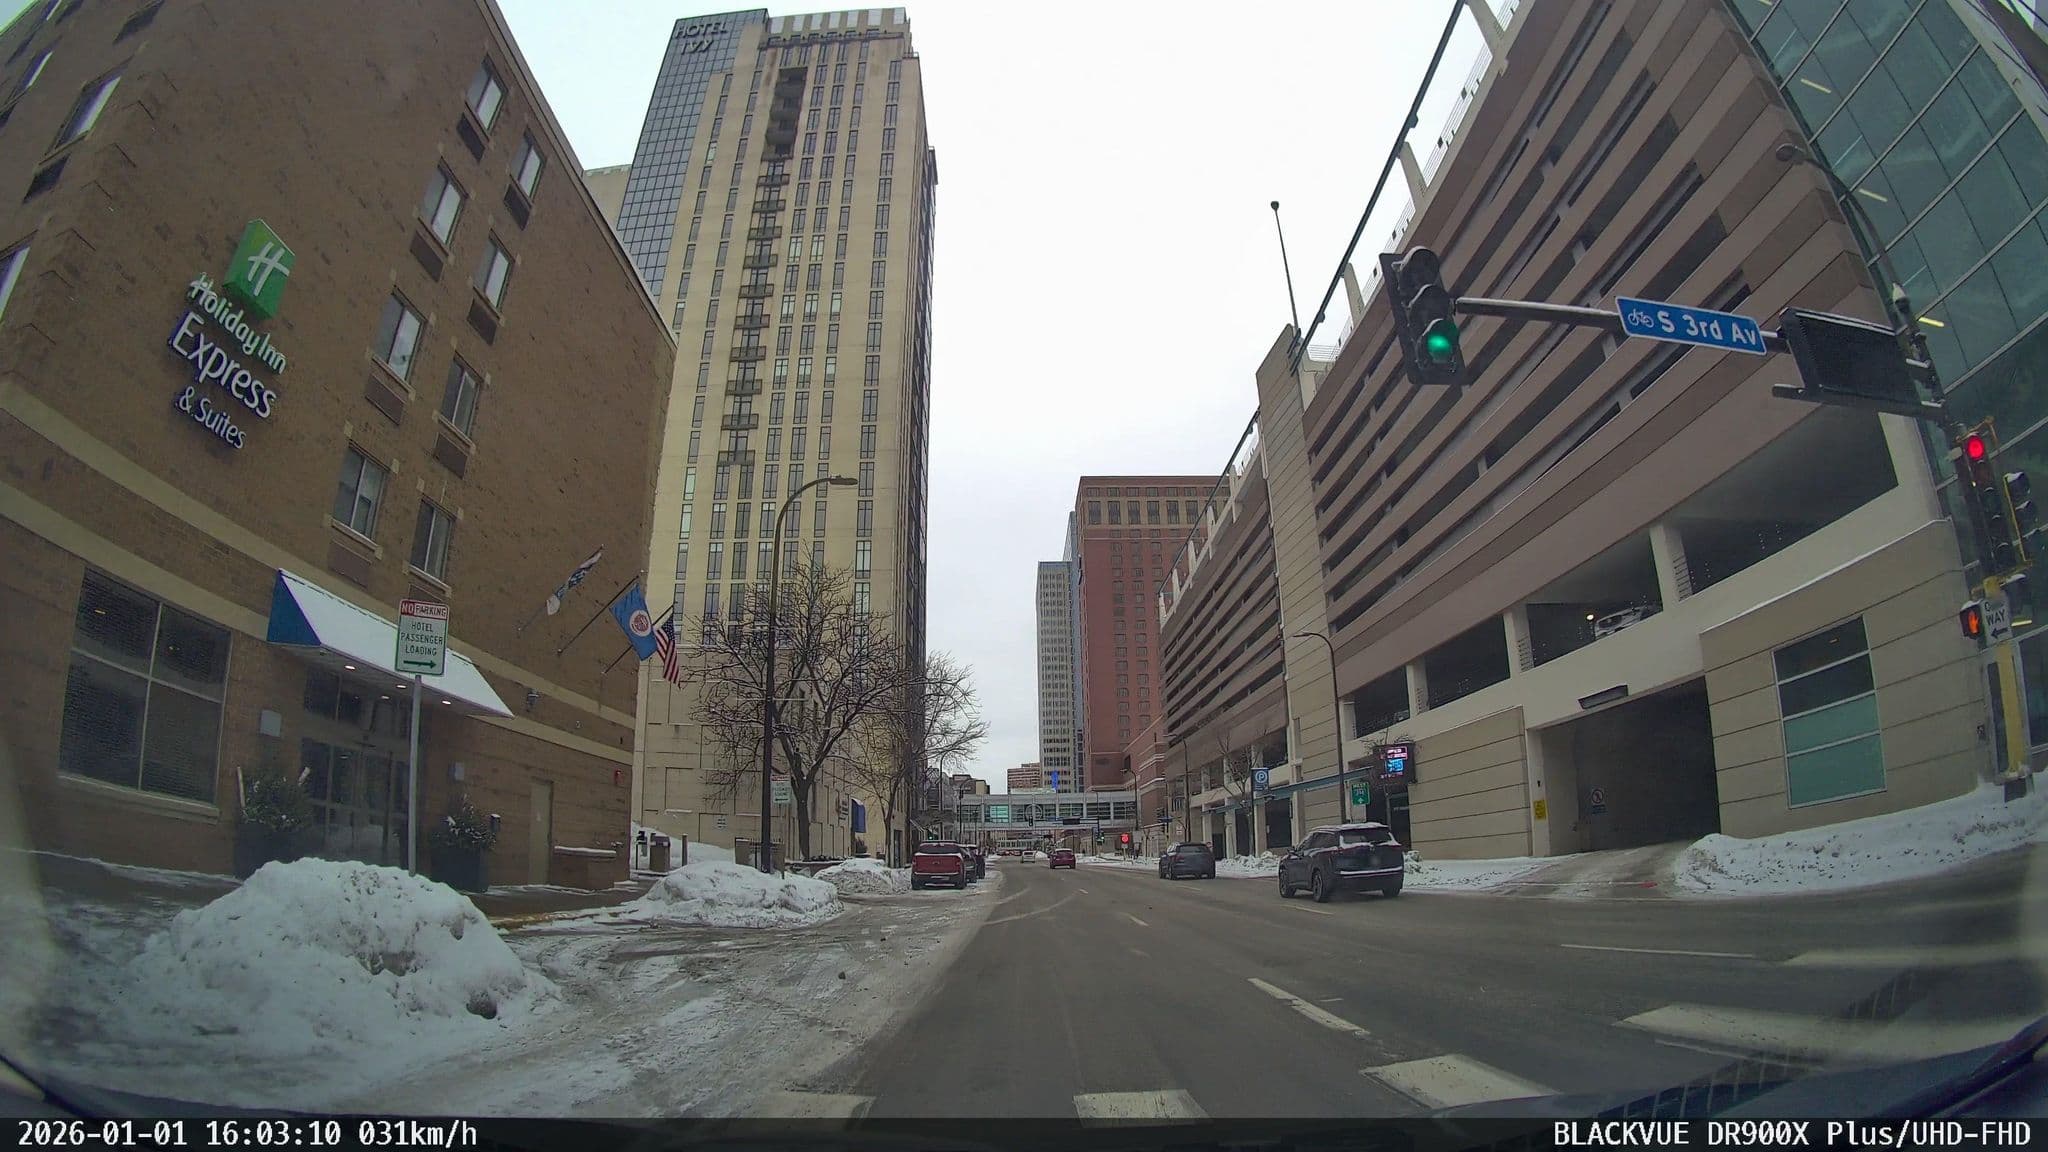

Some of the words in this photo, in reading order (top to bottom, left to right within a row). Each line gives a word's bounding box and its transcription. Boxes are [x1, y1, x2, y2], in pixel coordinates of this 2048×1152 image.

[675, 22, 728, 39] HOTEL
[680, 37, 714, 55] IVY
[188, 272, 260, 356] Holiday
[257, 333, 288, 375] Inn
[1657, 310, 1675, 333] S
[1682, 314, 1723, 340] 3rd
[1731, 321, 1756, 345] Av
[170, 310, 277, 418] Express
[177, 385, 196, 412] &
[193, 397, 247, 450] Suites
[401, 602, 414, 614] NO
[415, 604, 447, 617] PARKING
[1985, 609, 2006, 626] WAY
[411, 621, 434, 632] HOTEL
[400, 632, 443, 645] PASSENGER
[405, 645, 437, 656] LOADING
